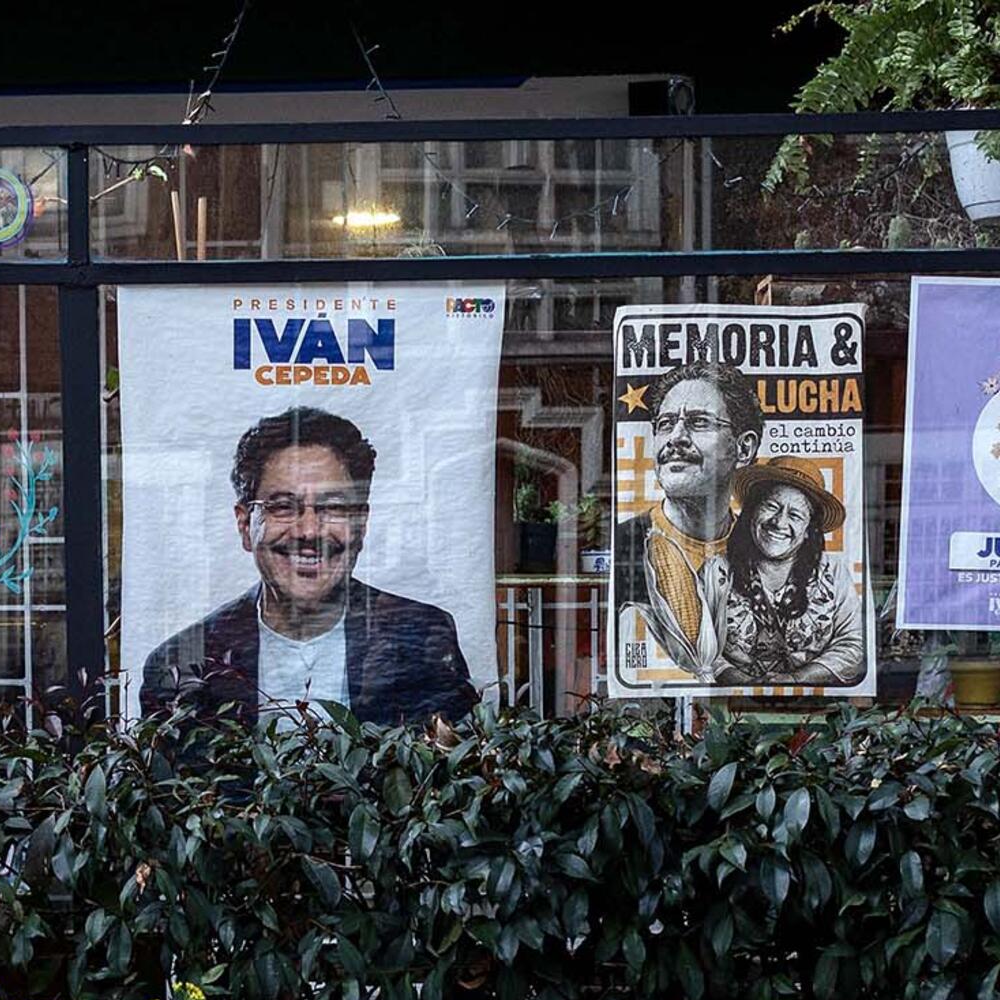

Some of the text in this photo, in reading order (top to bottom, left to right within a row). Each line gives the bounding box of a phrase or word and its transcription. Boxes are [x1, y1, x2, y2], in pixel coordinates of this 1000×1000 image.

[234, 298, 396, 311] PRESIDENTE
[233, 313, 395, 370] IVÁN
[622, 322, 858, 369] MEMORIA &
[254, 365, 371, 386] CEPEDA
[757, 378, 863, 414] LUCHA
[769, 423, 856, 438] el cambio
[769, 438, 856, 454] continúa
[958, 572, 974, 583] ES
